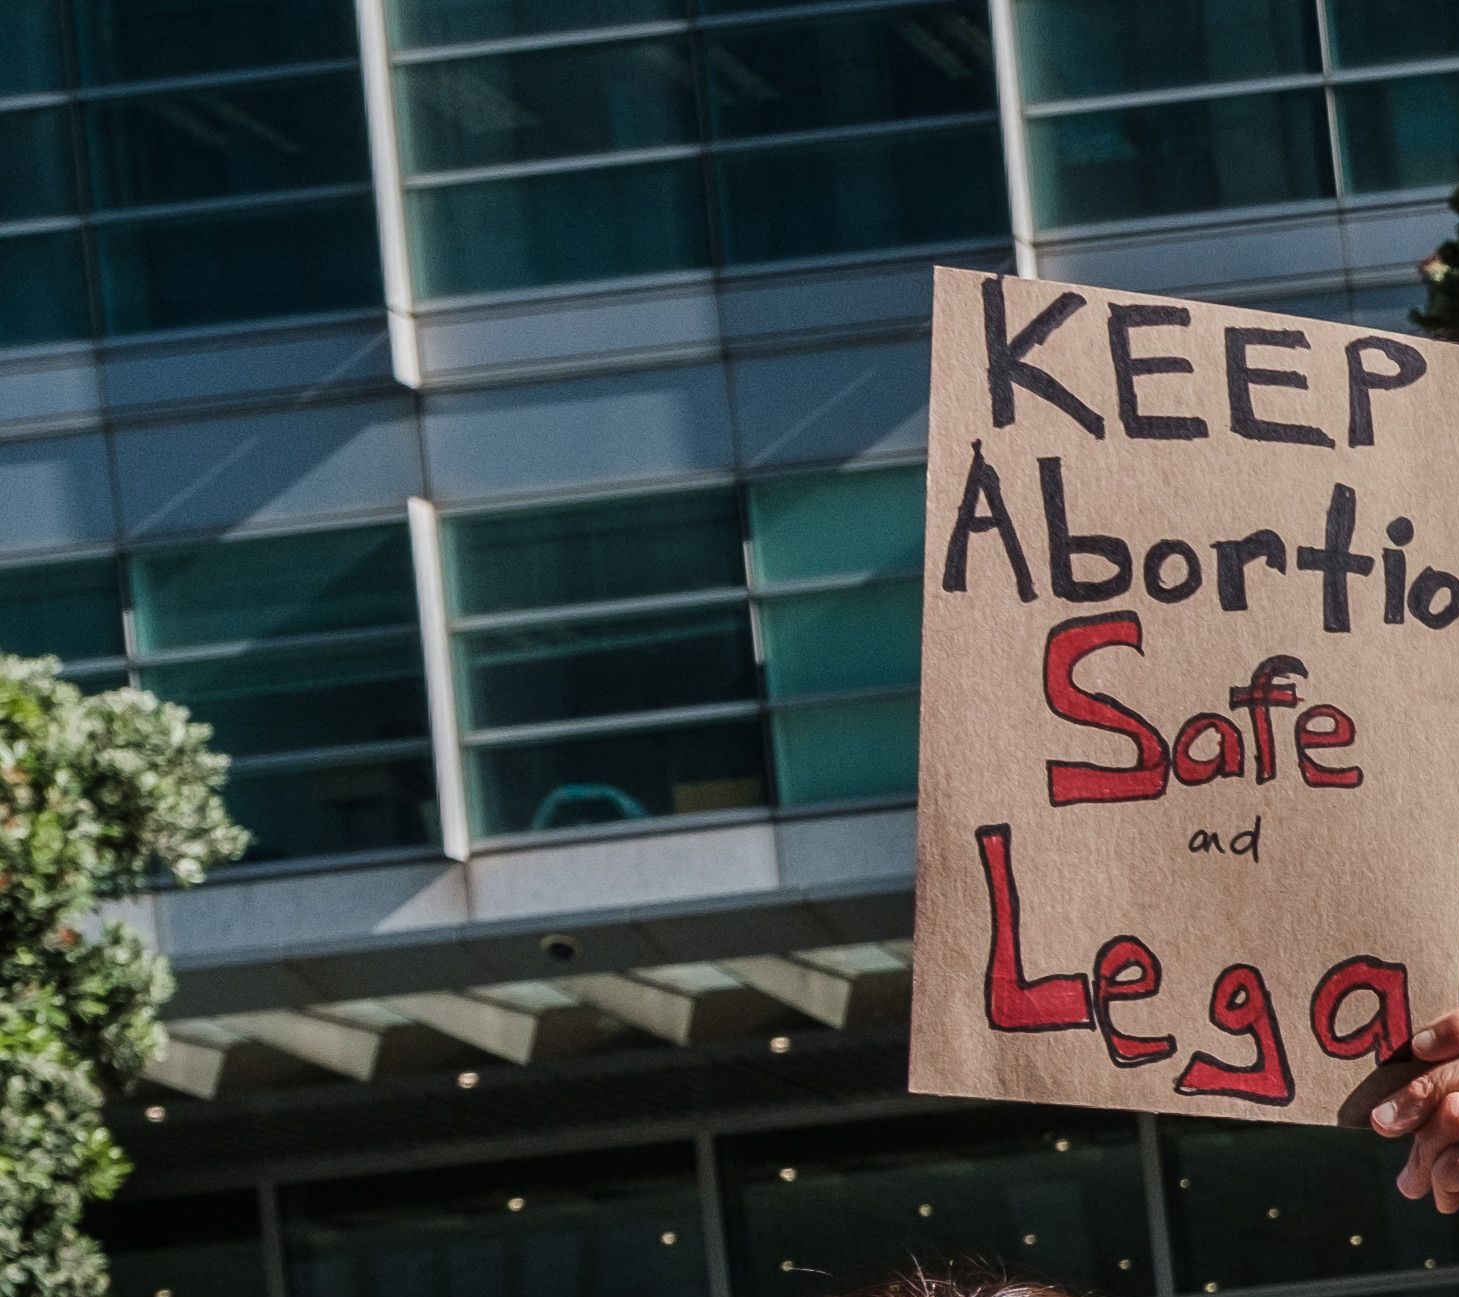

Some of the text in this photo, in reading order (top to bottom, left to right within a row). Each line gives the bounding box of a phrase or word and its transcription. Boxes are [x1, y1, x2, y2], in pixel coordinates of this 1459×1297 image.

[982, 278, 1427, 448] KEEP
[1043, 611, 1364, 807] Safe
[1188, 816, 1260, 863] and
